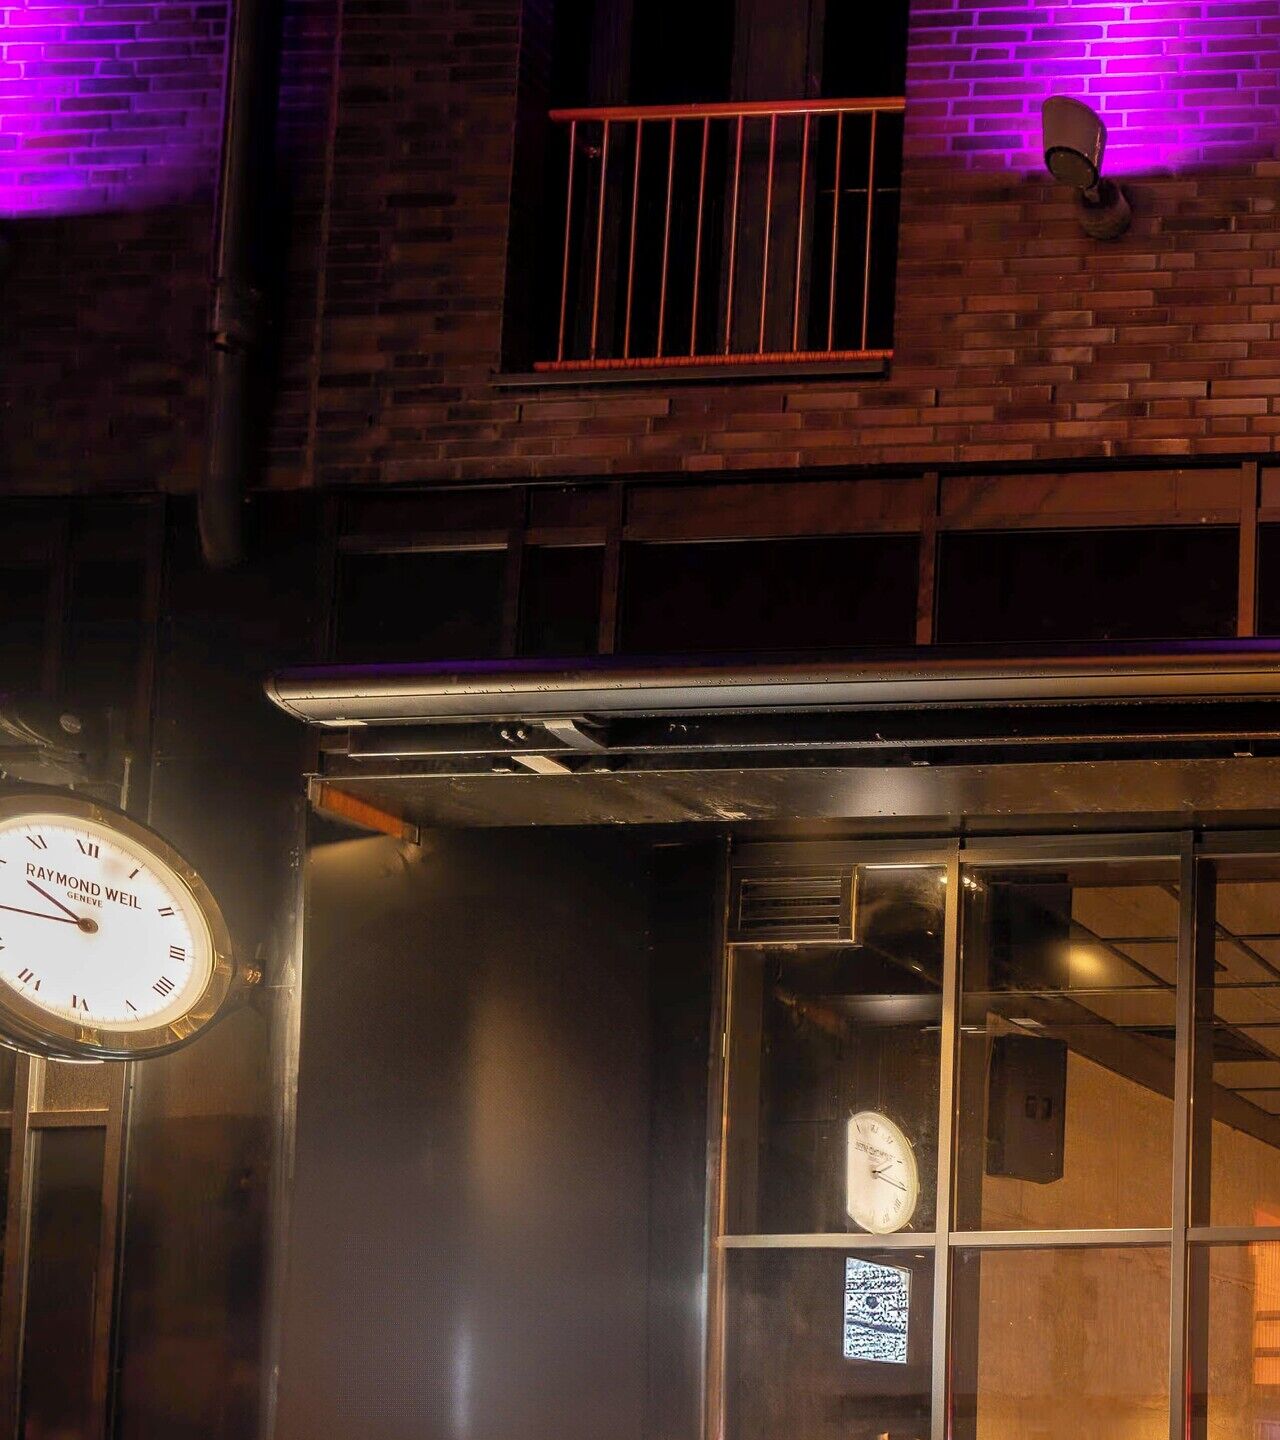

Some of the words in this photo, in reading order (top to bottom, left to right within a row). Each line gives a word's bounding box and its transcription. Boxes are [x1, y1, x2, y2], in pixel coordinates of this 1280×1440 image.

[26, 862, 101, 896] RAYMOND
[105, 886, 142, 910] WEIL
[67, 890, 103, 908] GENEVE
